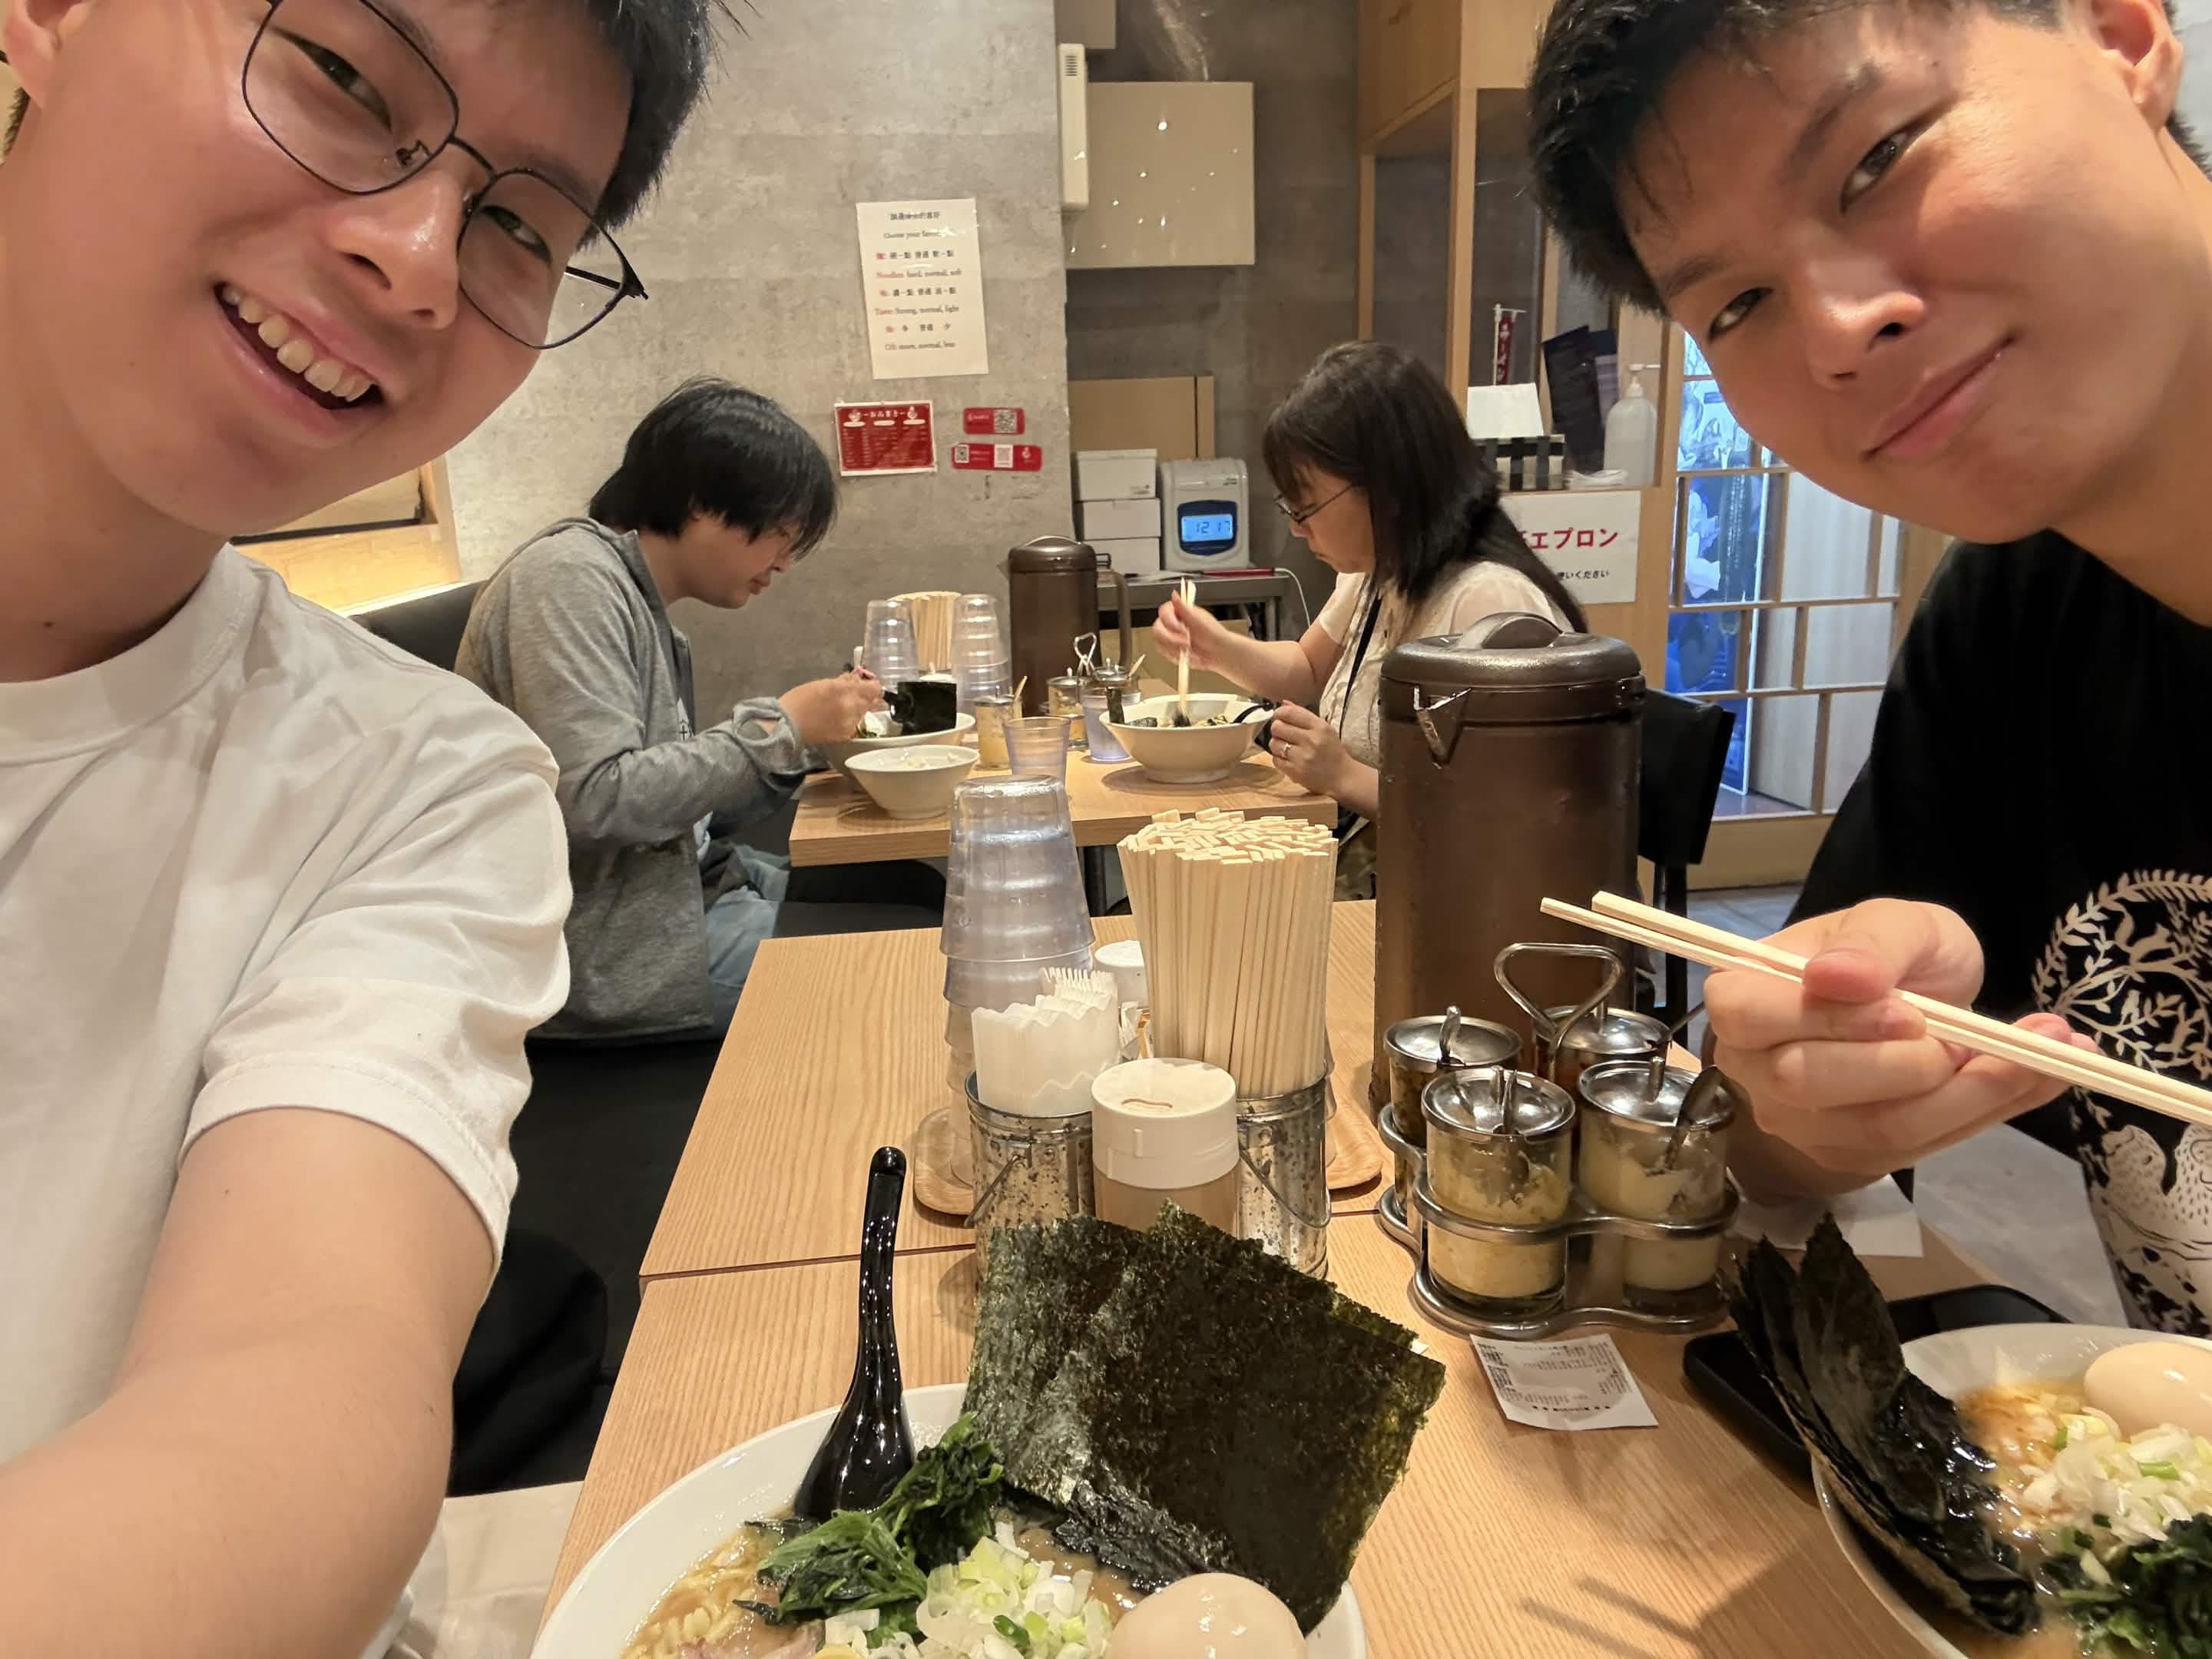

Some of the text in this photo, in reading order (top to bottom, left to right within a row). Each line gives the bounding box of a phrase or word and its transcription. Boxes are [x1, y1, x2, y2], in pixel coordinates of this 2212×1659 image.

[1196, 521, 1210, 534] 12
[1519, 527, 1618, 549] エプロン
